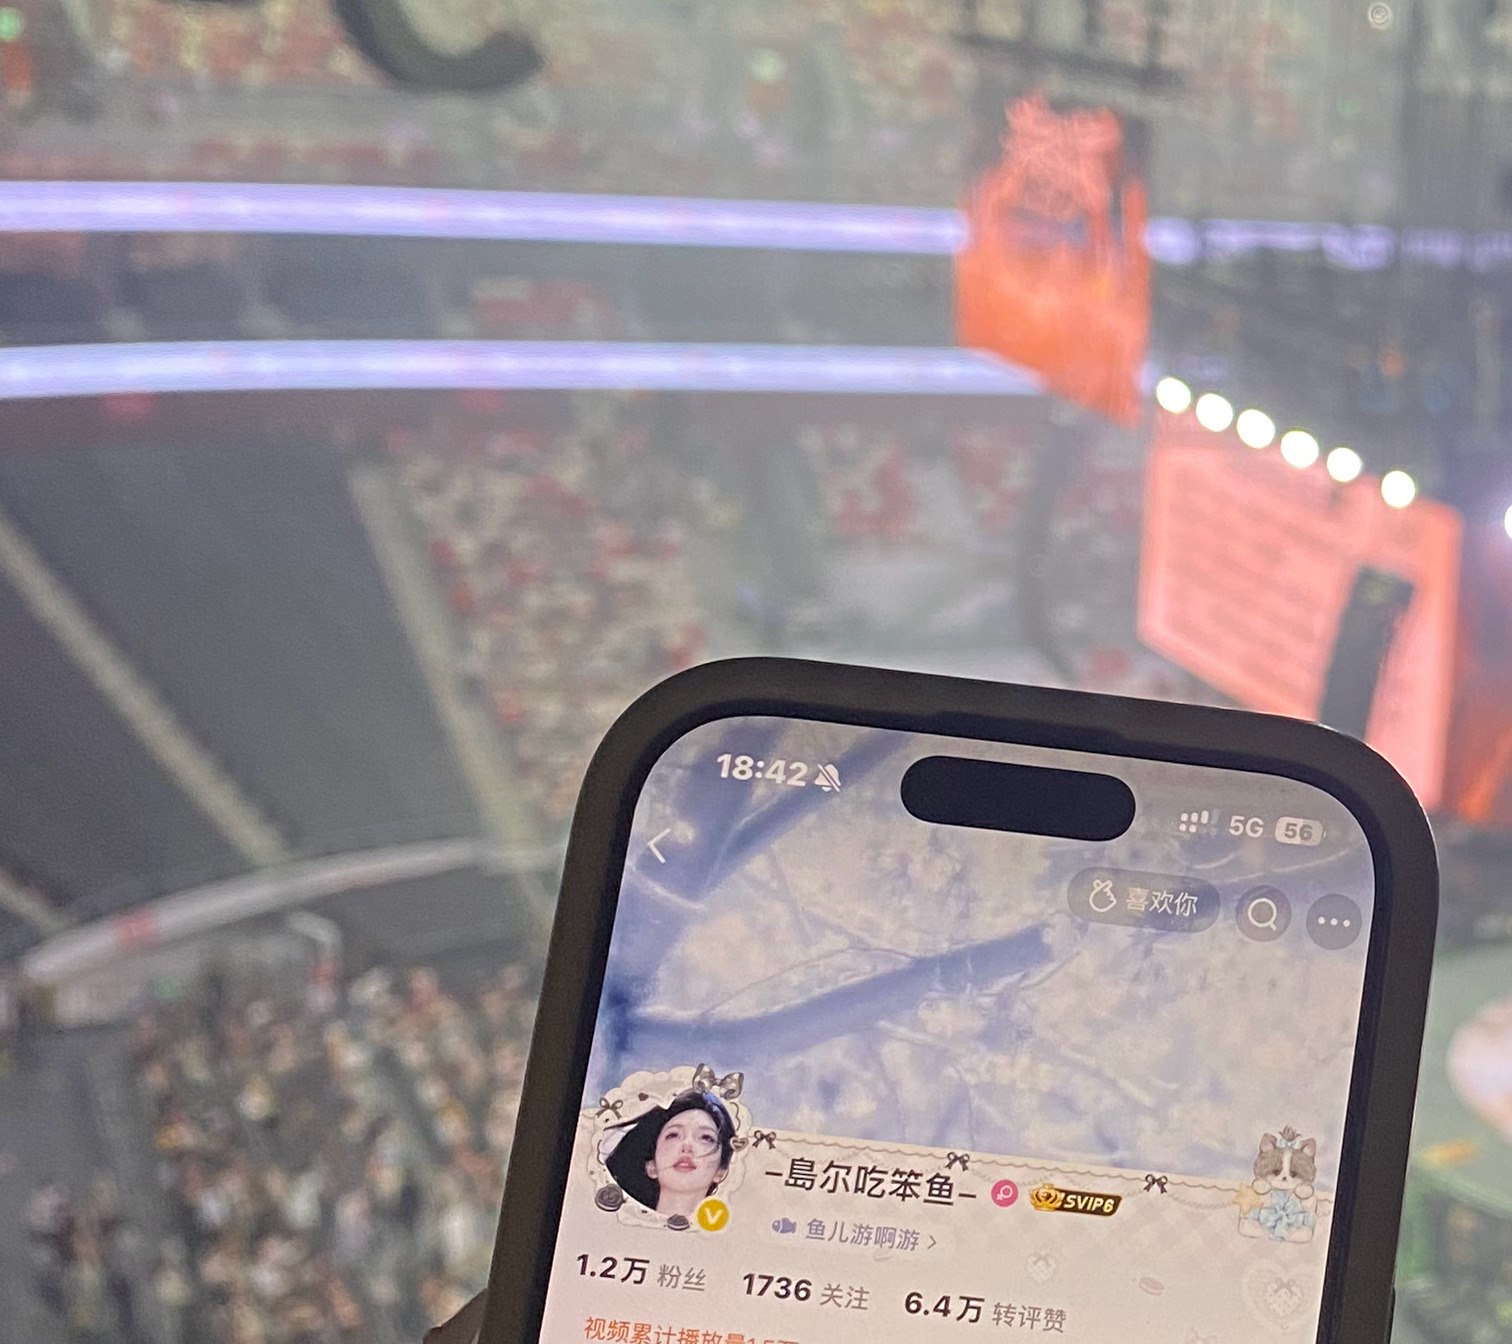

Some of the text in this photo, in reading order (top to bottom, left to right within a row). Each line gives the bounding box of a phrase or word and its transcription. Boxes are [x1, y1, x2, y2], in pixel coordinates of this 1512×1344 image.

[716, 753, 808, 787] 18:42
[1228, 815, 1315, 841] 5G 56
[1125, 885, 1199, 917] 喜欢你
[1063, 1193, 1115, 1214] SVIP6
[805, 1217, 921, 1251] 鱼儿游啊游
[576, 1253, 1068, 1334] 1.2万 粉丝 1736 关注 6.4万 转评赞
